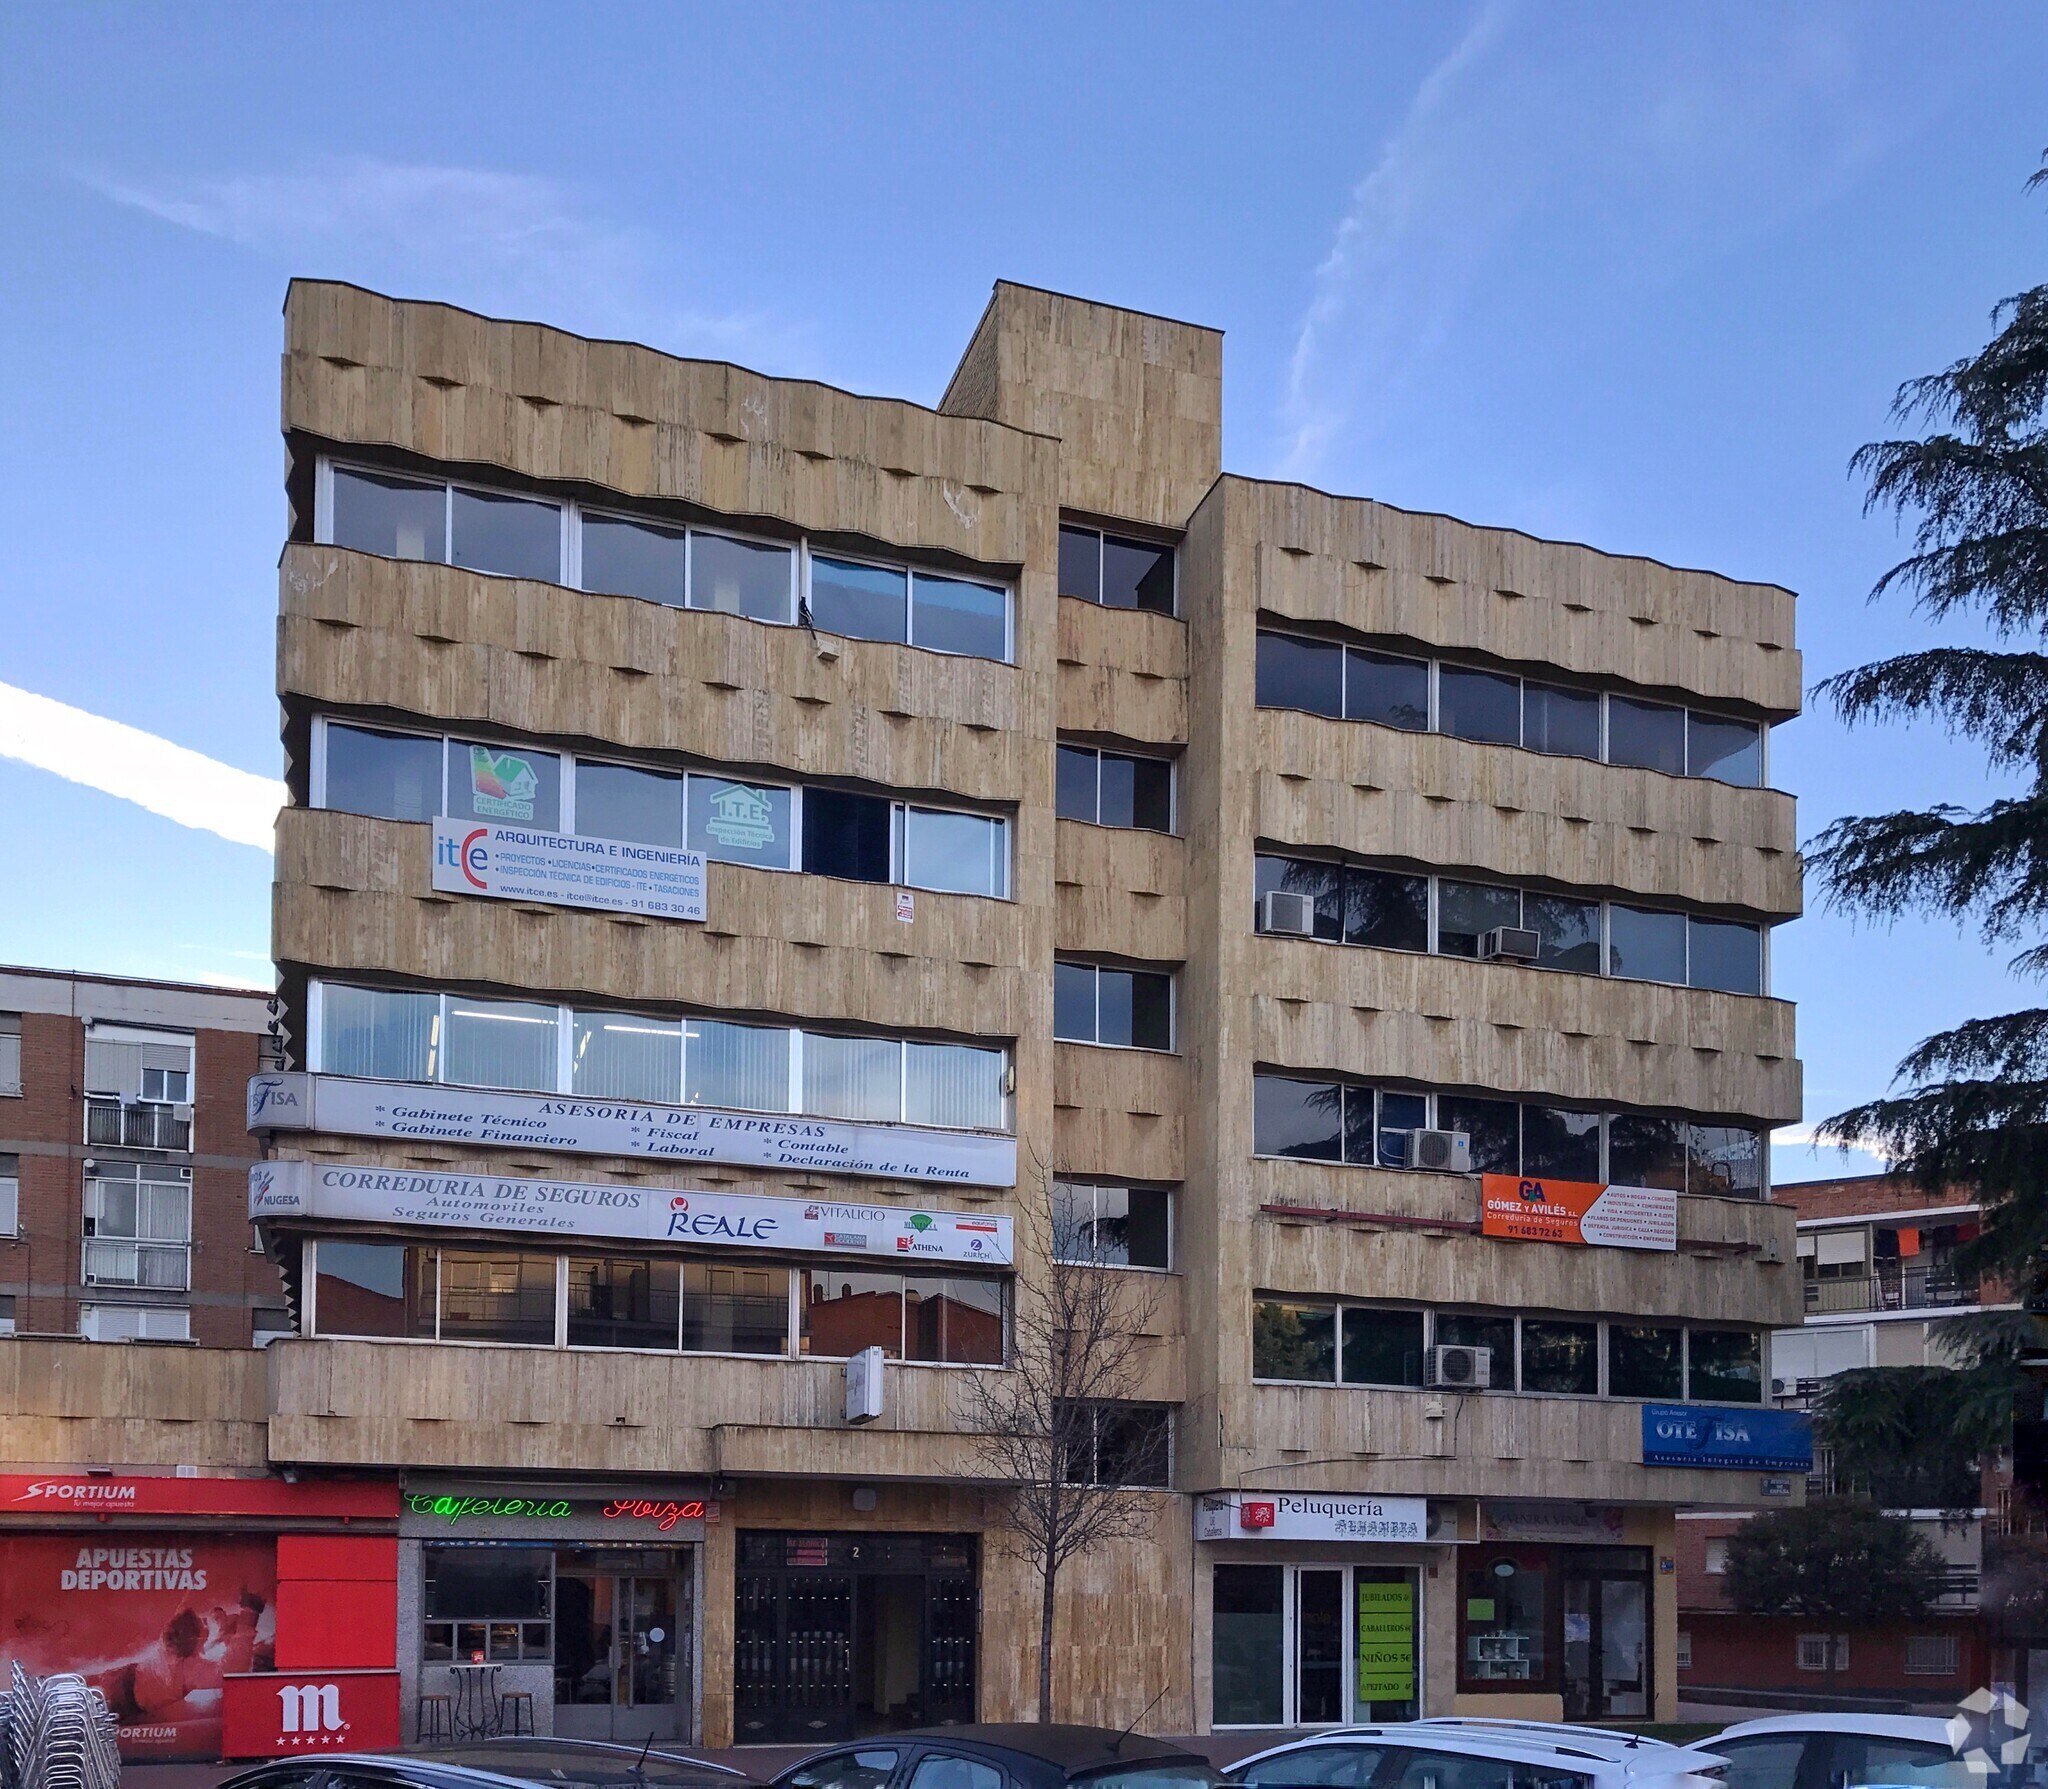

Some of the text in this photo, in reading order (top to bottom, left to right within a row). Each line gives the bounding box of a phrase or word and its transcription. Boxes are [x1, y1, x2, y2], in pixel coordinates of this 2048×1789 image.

[477, 797, 531, 811] CERTIFICADO
[721, 800, 766, 821] I.T.E.
[495, 830, 701, 867] ARQUITECTURA E INGENIERÍA
[500, 852, 546, 866] PROYECTOS
[552, 859, 592, 872] LICENCIAS
[595, 864, 648, 880] CERTIFICADOS
[583, 875, 594, 885] DE
[595, 876, 631, 889] EDIFICIOS
[636, 881, 648, 892] ITE
[654, 883, 700, 898] TASACIONES
[500, 885, 701, 916] www.itce.es itce@itce.es 91 683 30 46
[392, 1106, 548, 1129] Gabinete Técnico
[538, 1102, 826, 1138] ASESORIA DE EMPRESAS
[392, 1121, 578, 1146] Gabinete Financiero
[647, 1127, 700, 1142] Fiscal
[647, 1142, 716, 1157] Laboral
[777, 1139, 849, 1155] Contable
[778, 1152, 970, 1179] Declaración de la Renta
[264, 1195, 301, 1206] NUGESA
[322, 1171, 641, 1209] CORREDURIA DE SEGUROS
[392, 1206, 576, 1229] Seguros Generales
[820, 1206, 886, 1222] VITALICIO
[1487, 1198, 1522, 1212] GÓMEZ
[1531, 1203, 1567, 1216] AVILÉS
[667, 1211, 779, 1240] REALE
[1507, 1225, 1563, 1238] 91 683 72 63
[1533, 1215, 1543, 1224] de
[1545, 1216, 1578, 1227] Seguros
[912, 1243, 944, 1253] ATHENA
[963, 1251, 990, 1260] ZURICH
[11, 1480, 135, 1502] SPORTIUM
[1277, 1497, 1384, 1518] Peluquería
[75, 1548, 193, 1569] APUESTAS
[853, 1546, 860, 1558] 2
[60, 1569, 207, 1591] DEPORTIVAS
[1361, 1624, 1404, 1633] CABALLEROS
[1361, 1651, 1398, 1663] NIÑOS
